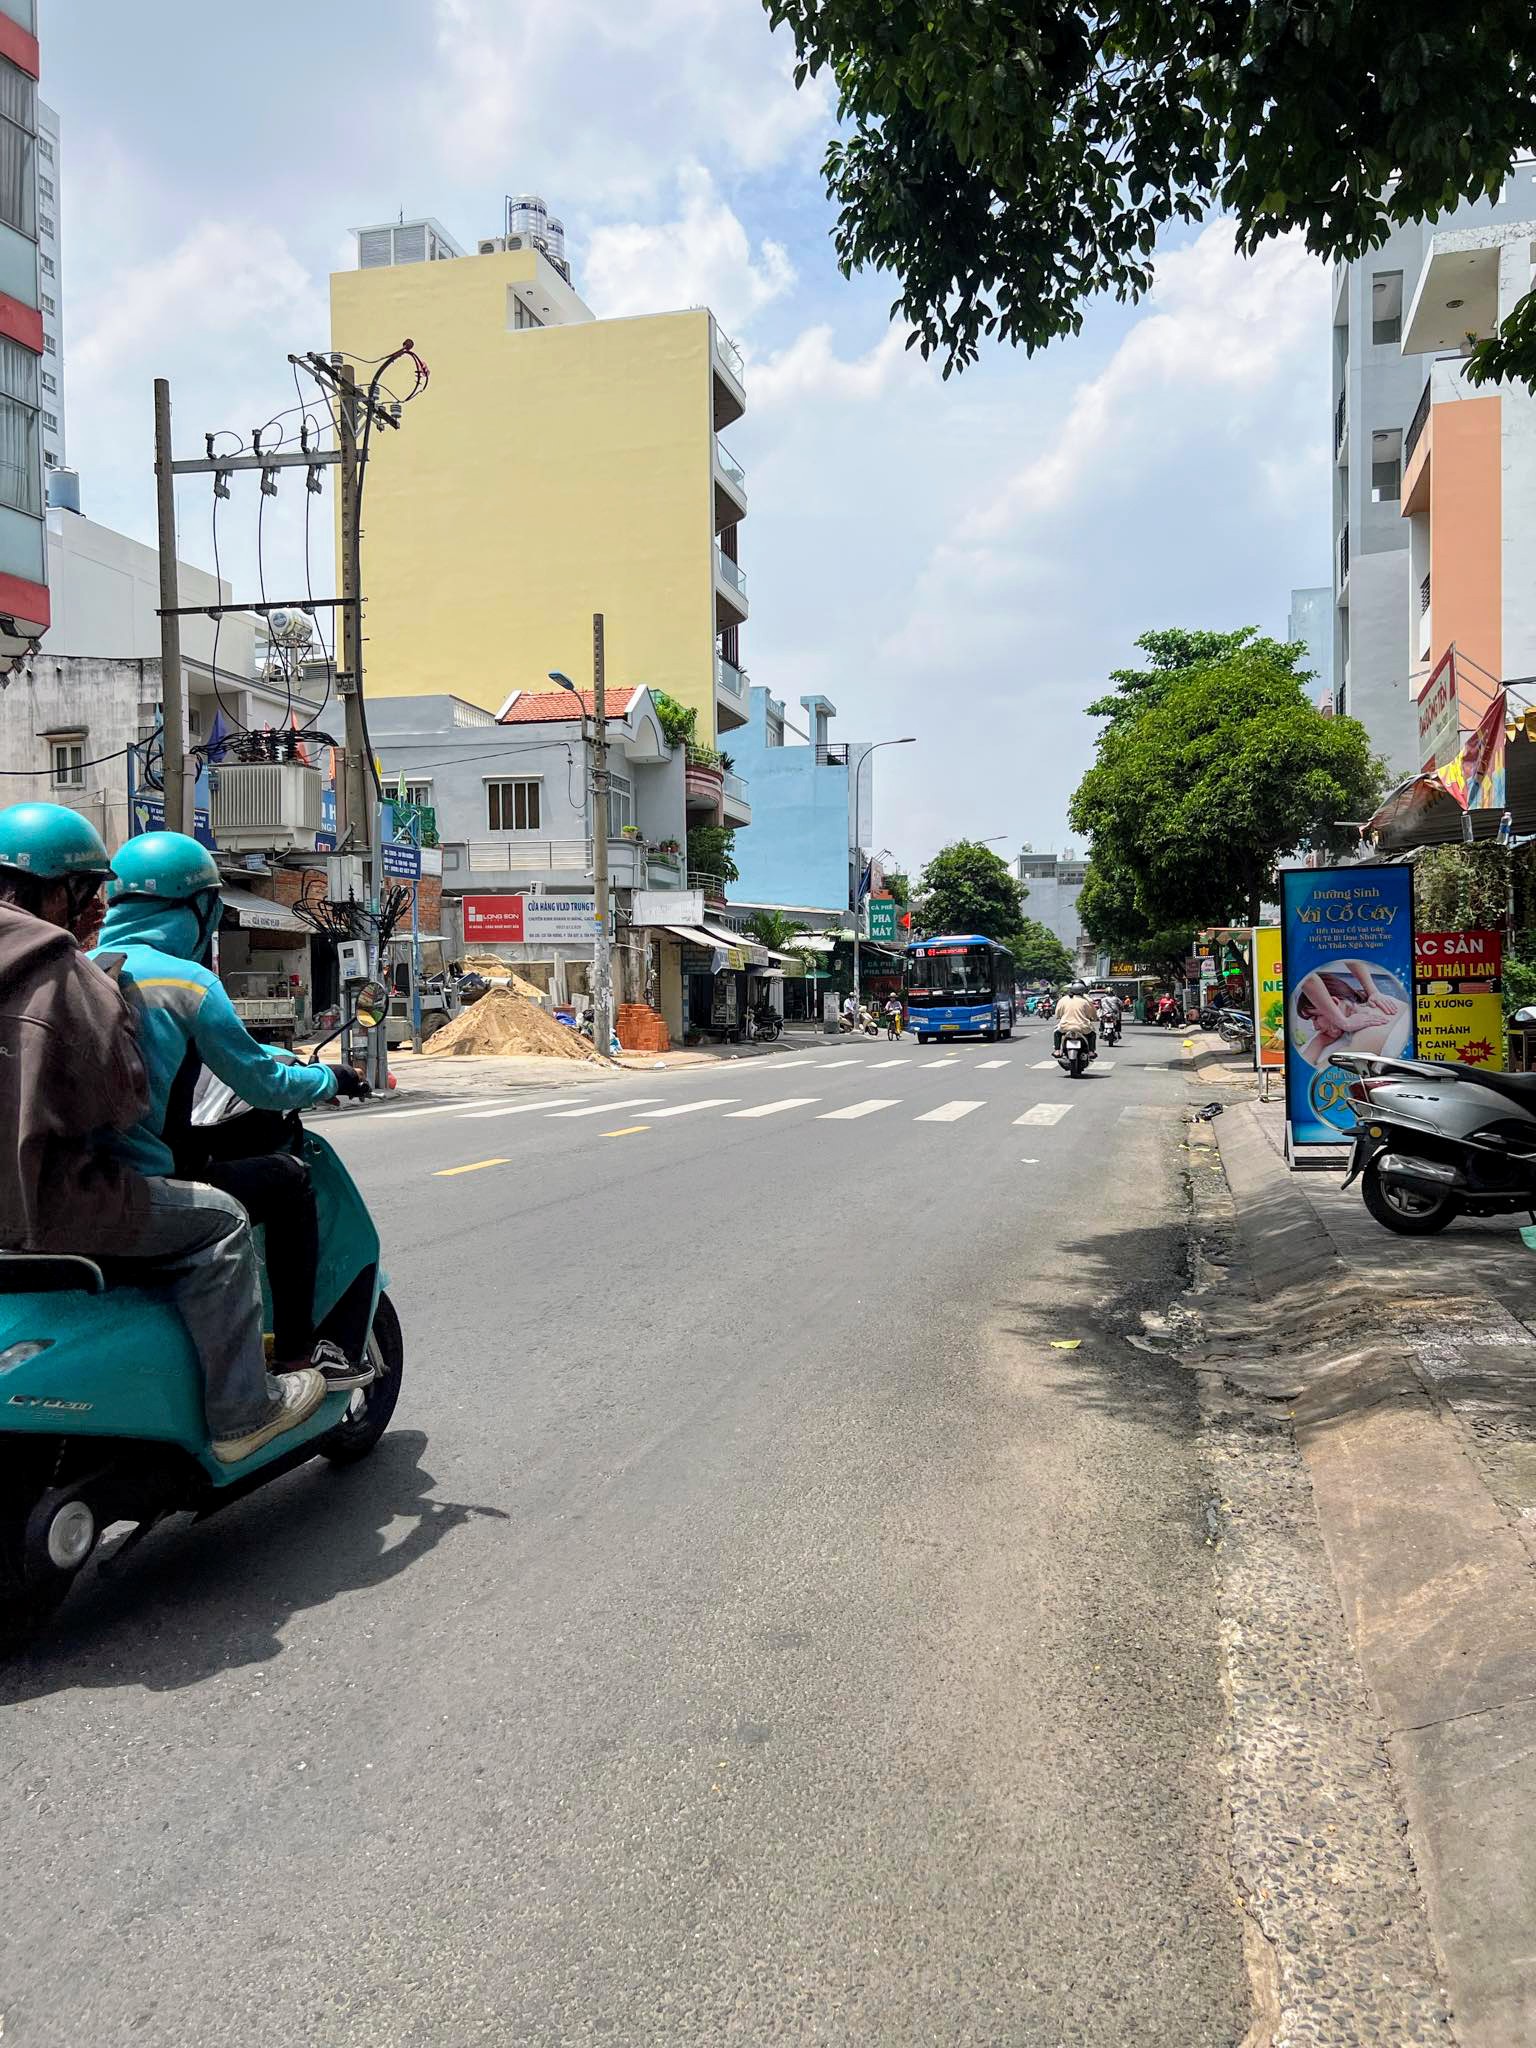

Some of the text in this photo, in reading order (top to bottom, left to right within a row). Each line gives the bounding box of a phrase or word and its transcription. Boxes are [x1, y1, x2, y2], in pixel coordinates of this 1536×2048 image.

[1353, 887, 1380, 897] Sinh
[540, 901, 555, 911] HÀNG
[571, 902, 590, 911] TRUNG
[1326, 902, 1354, 922] Cổ
[872, 914, 892, 923] PHA
[872, 925, 893, 936] MÁY
[1444, 935, 1484, 955] SẢN
[1415, 960, 1495, 978] ẾU THÁI LAN
[1263, 981, 1283, 992] NE
[1418, 997, 1473, 1009] ẾU XƯƠNG
[1420, 1013, 1432, 1023] MÌ
[1417, 1024, 1471, 1035] NH THÁNH
[1425, 1040, 1457, 1049] CANH
[1465, 1048, 1485, 1057] 30k
